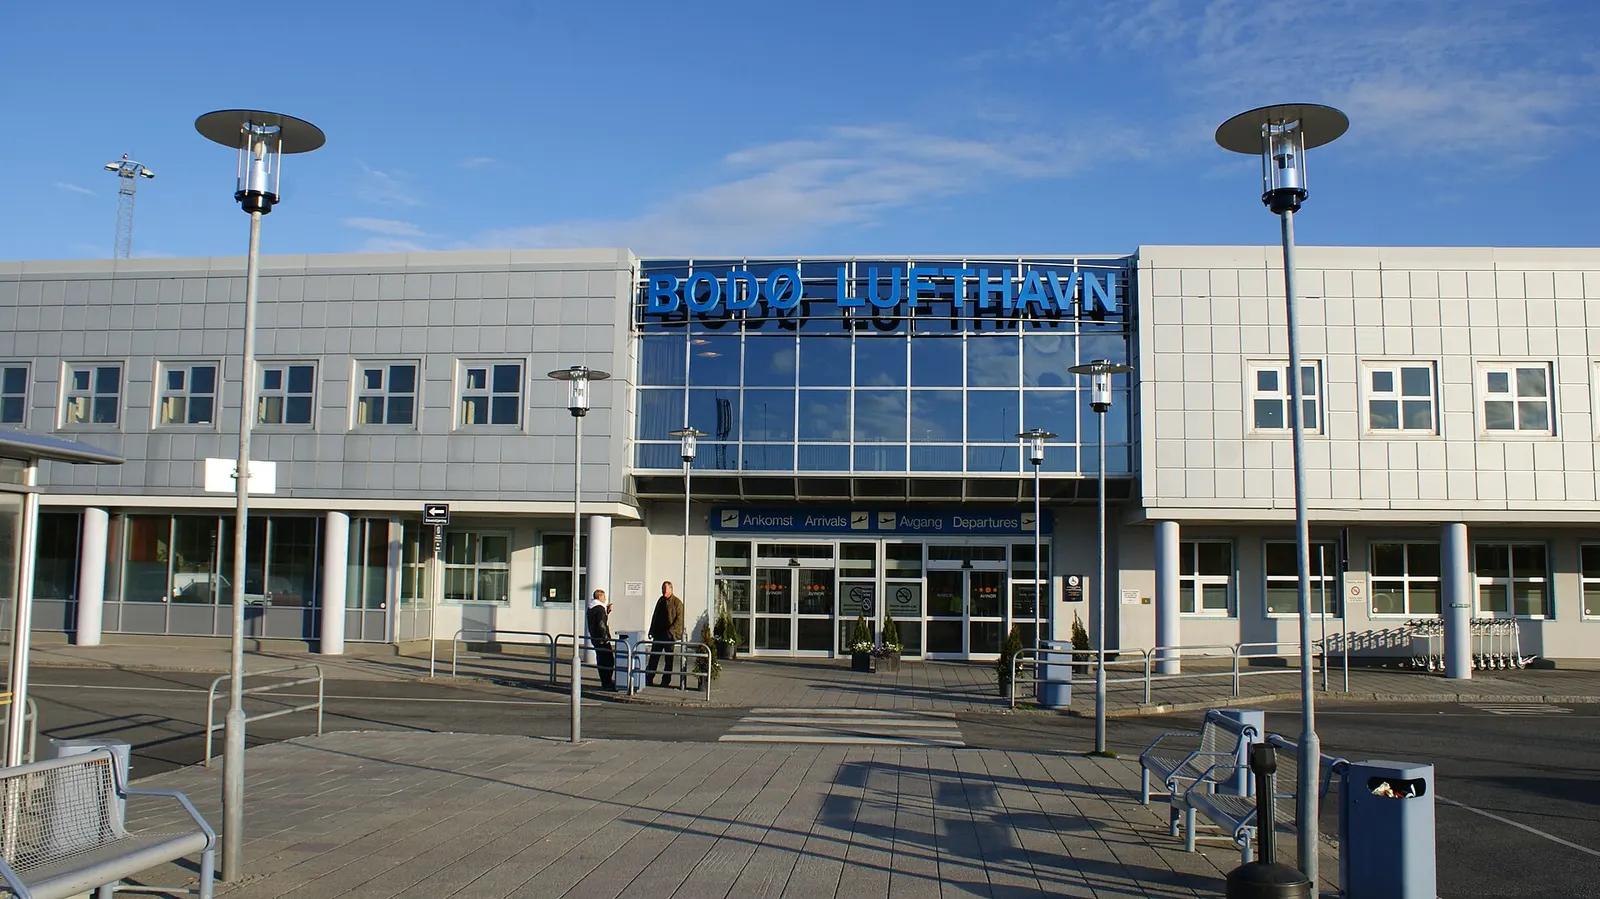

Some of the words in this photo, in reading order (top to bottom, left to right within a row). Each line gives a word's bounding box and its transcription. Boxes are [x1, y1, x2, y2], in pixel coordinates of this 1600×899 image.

[647, 268, 803, 315] BODØ
[837, 267, 1116, 313] LUFTHAVN
[743, 514, 793, 526] Ankomst
[805, 515, 847, 527] Arrivals
[900, 516, 943, 529] Avgang
[953, 516, 1018, 529] Departures
